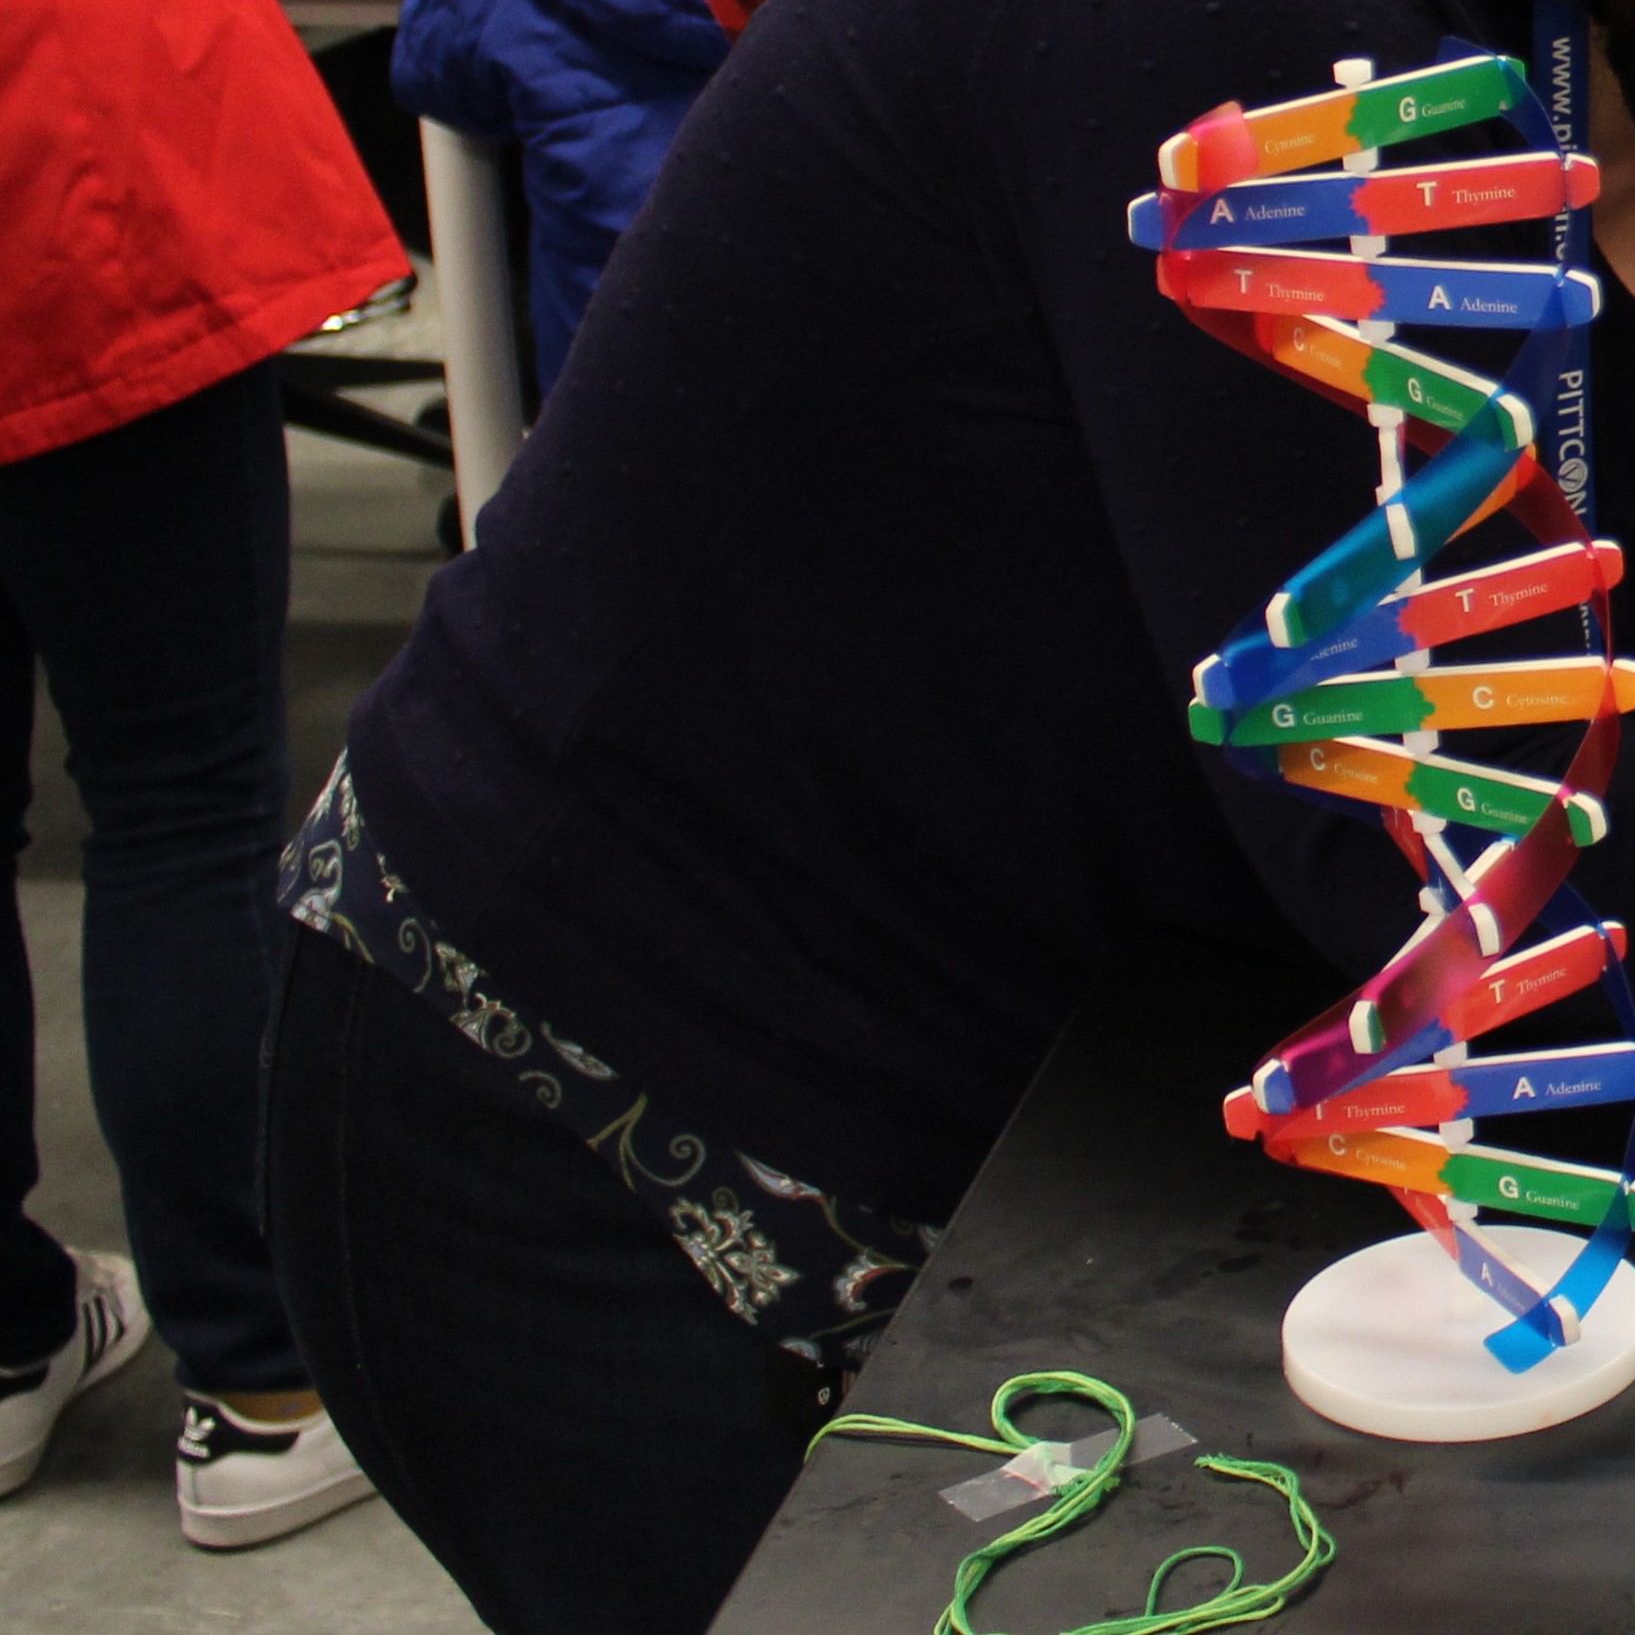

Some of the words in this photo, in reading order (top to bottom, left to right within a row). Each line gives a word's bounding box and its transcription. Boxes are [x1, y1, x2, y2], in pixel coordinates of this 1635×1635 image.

[1399, 95, 1417, 123] G
[1421, 95, 1466, 117] Guanine
[1264, 131, 1314, 155] Cytosine
[1416, 180, 1438, 207] T
[1451, 184, 1515, 205] Thymine
[1209, 198, 1234, 224] A
[1244, 203, 1305, 222] Adenine
[1233, 269, 1254, 294] T
[1265, 281, 1325, 304] Thymine
[1427, 284, 1451, 311] A
[1459, 296, 1518, 314] Adenine
[1293, 327, 1305, 352] C
[1407, 377, 1423, 404] G
[1455, 588, 1474, 614] T
[1488, 580, 1548, 608] Thymine
[1472, 685, 1494, 710] C
[1506, 692, 1567, 708] Cytosine
[1272, 704, 1295, 729] G
[1303, 708, 1363, 725] Guanine
[1310, 747, 1326, 772] C
[1456, 787, 1477, 814] G
[1481, 800, 1528, 825] Guanine
[1488, 979, 1506, 1004] T
[1515, 964, 1567, 996] Thymine
[1512, 1076, 1536, 1100] A
[1545, 1078, 1602, 1097] Adenine
[1343, 1103, 1406, 1119] Thymine
[1328, 1133, 1346, 1156] C
[1498, 1175, 1520, 1199] G
[1526, 1190, 1580, 1210] Guanine
[1480, 1262, 1494, 1288] A
